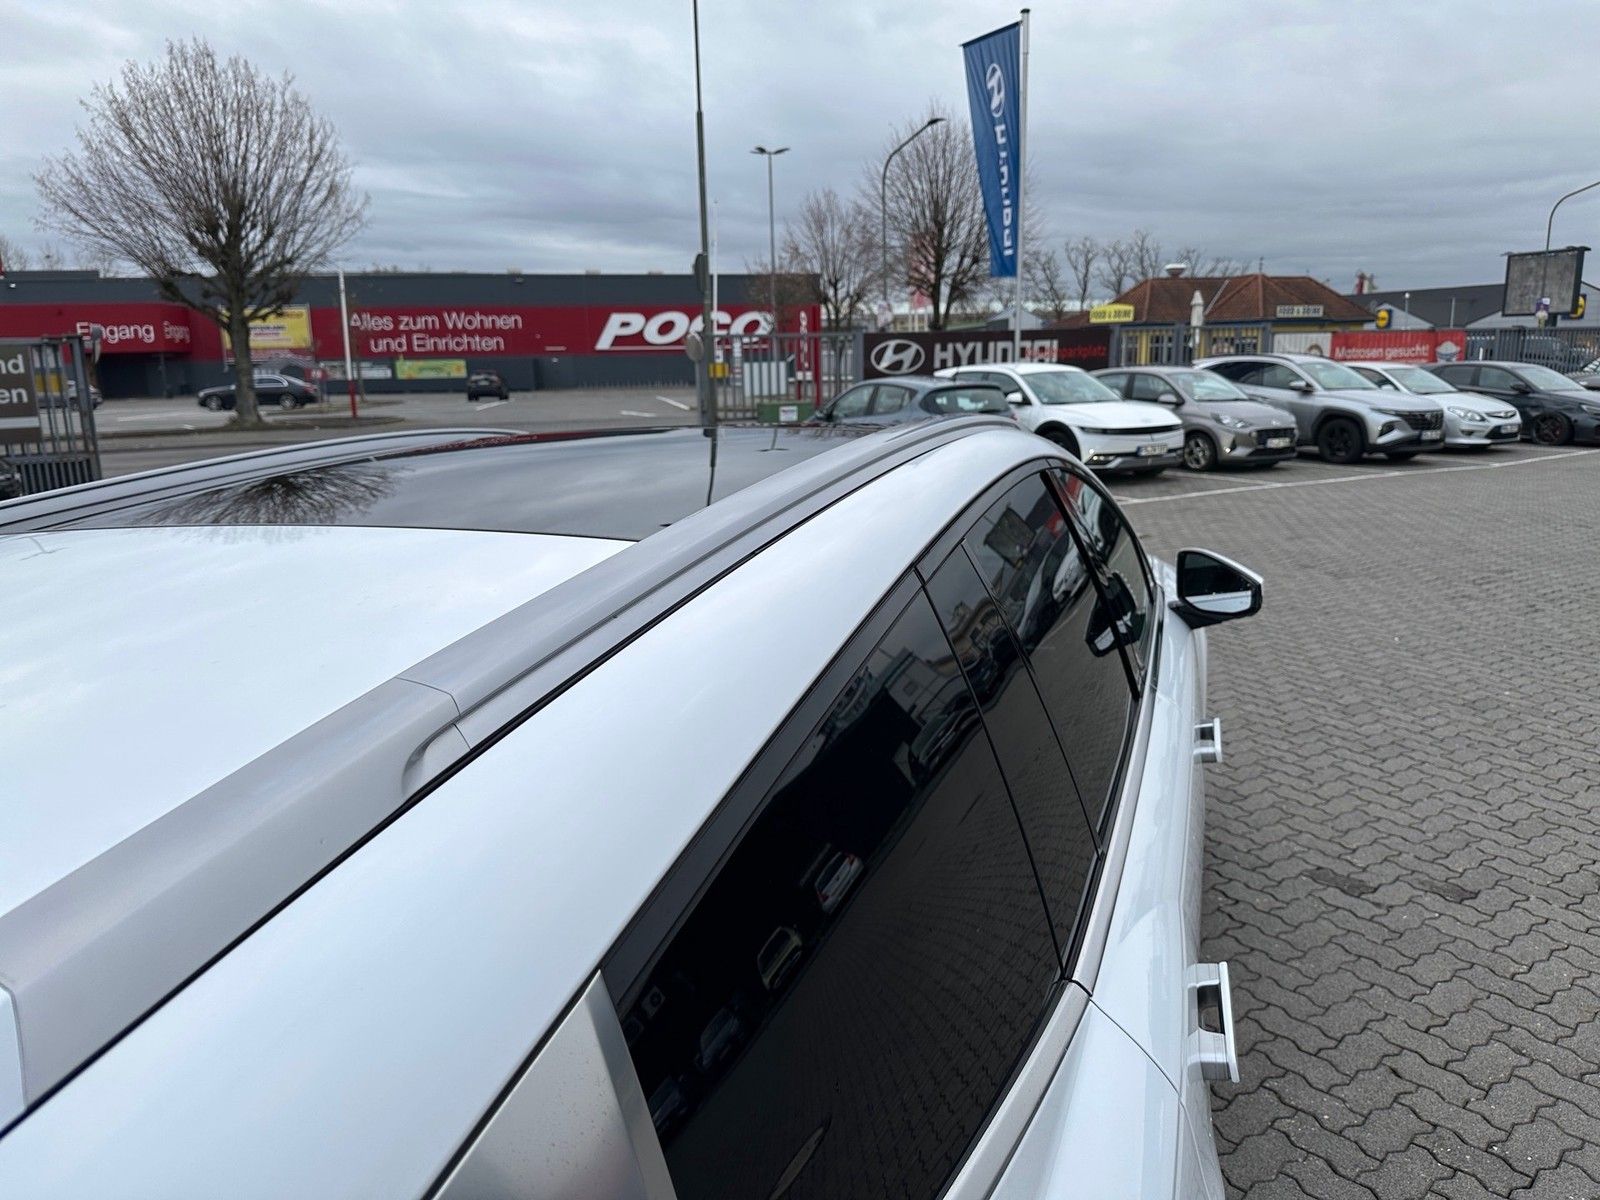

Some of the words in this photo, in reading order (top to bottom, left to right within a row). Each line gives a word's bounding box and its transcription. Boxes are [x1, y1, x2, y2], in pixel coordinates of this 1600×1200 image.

[350, 312, 394, 331] Alles
[399, 314, 439, 330] zum
[443, 311, 523, 330] Wohnen
[595, 310, 775, 351] POCO
[370, 333, 407, 352] und
[412, 333, 505, 352] Einrichten
[933, 338, 1059, 369] HYUNDAI
